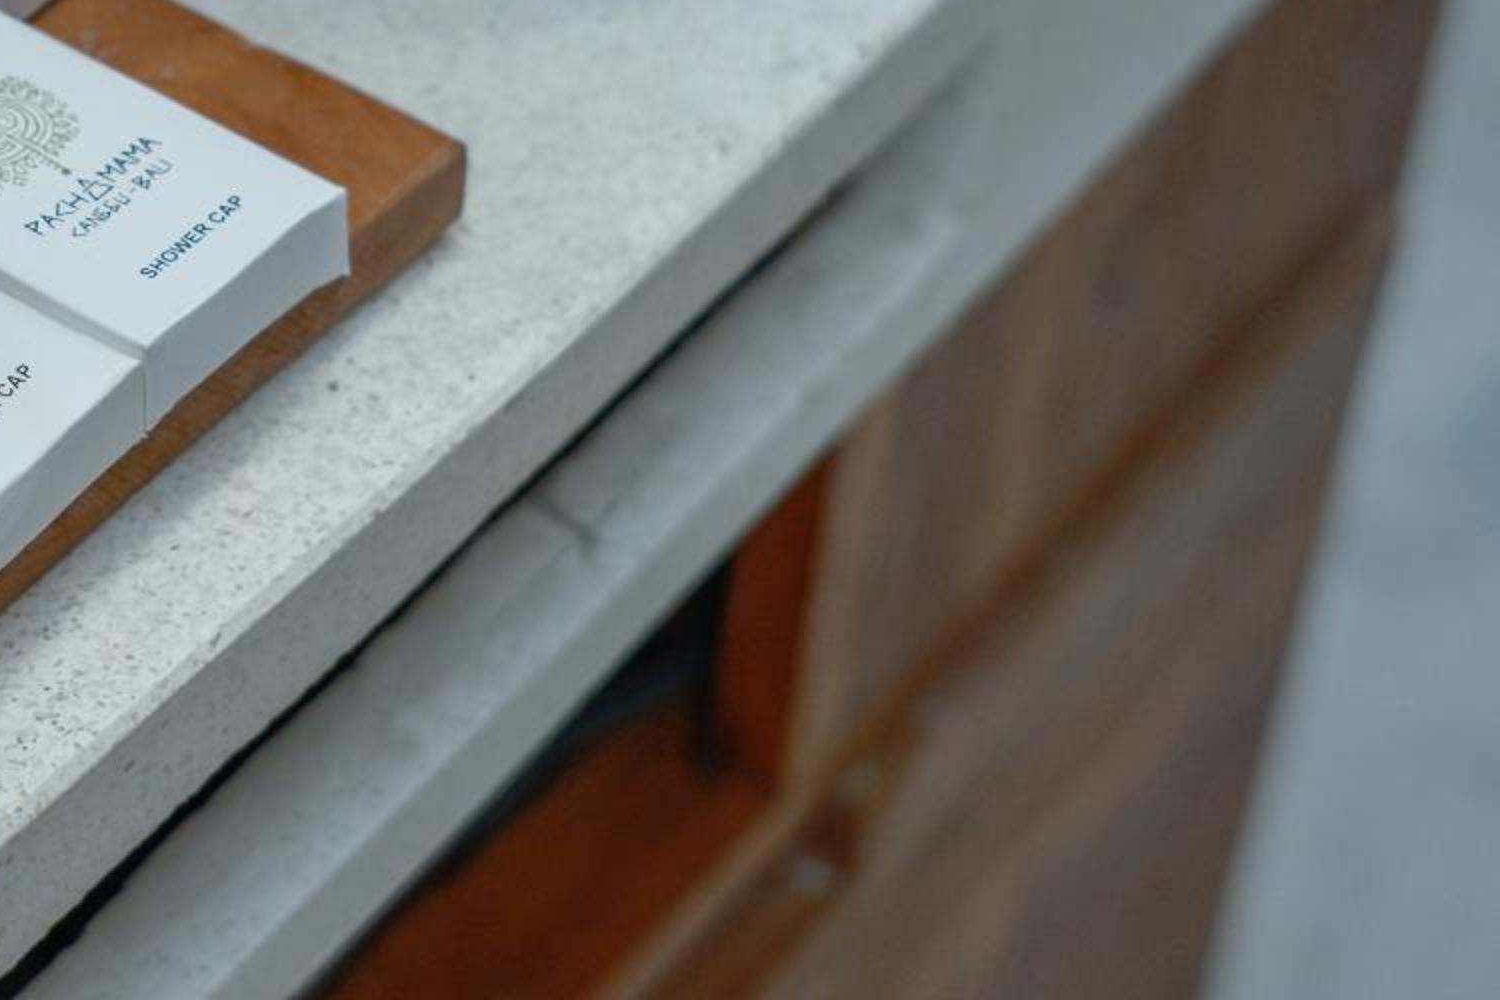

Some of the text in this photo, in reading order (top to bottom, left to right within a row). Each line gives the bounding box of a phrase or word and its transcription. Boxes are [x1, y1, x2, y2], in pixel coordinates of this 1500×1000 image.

[23, 137, 162, 235] PACHAMAMA
[140, 195, 242, 279] SHOWER CAP
